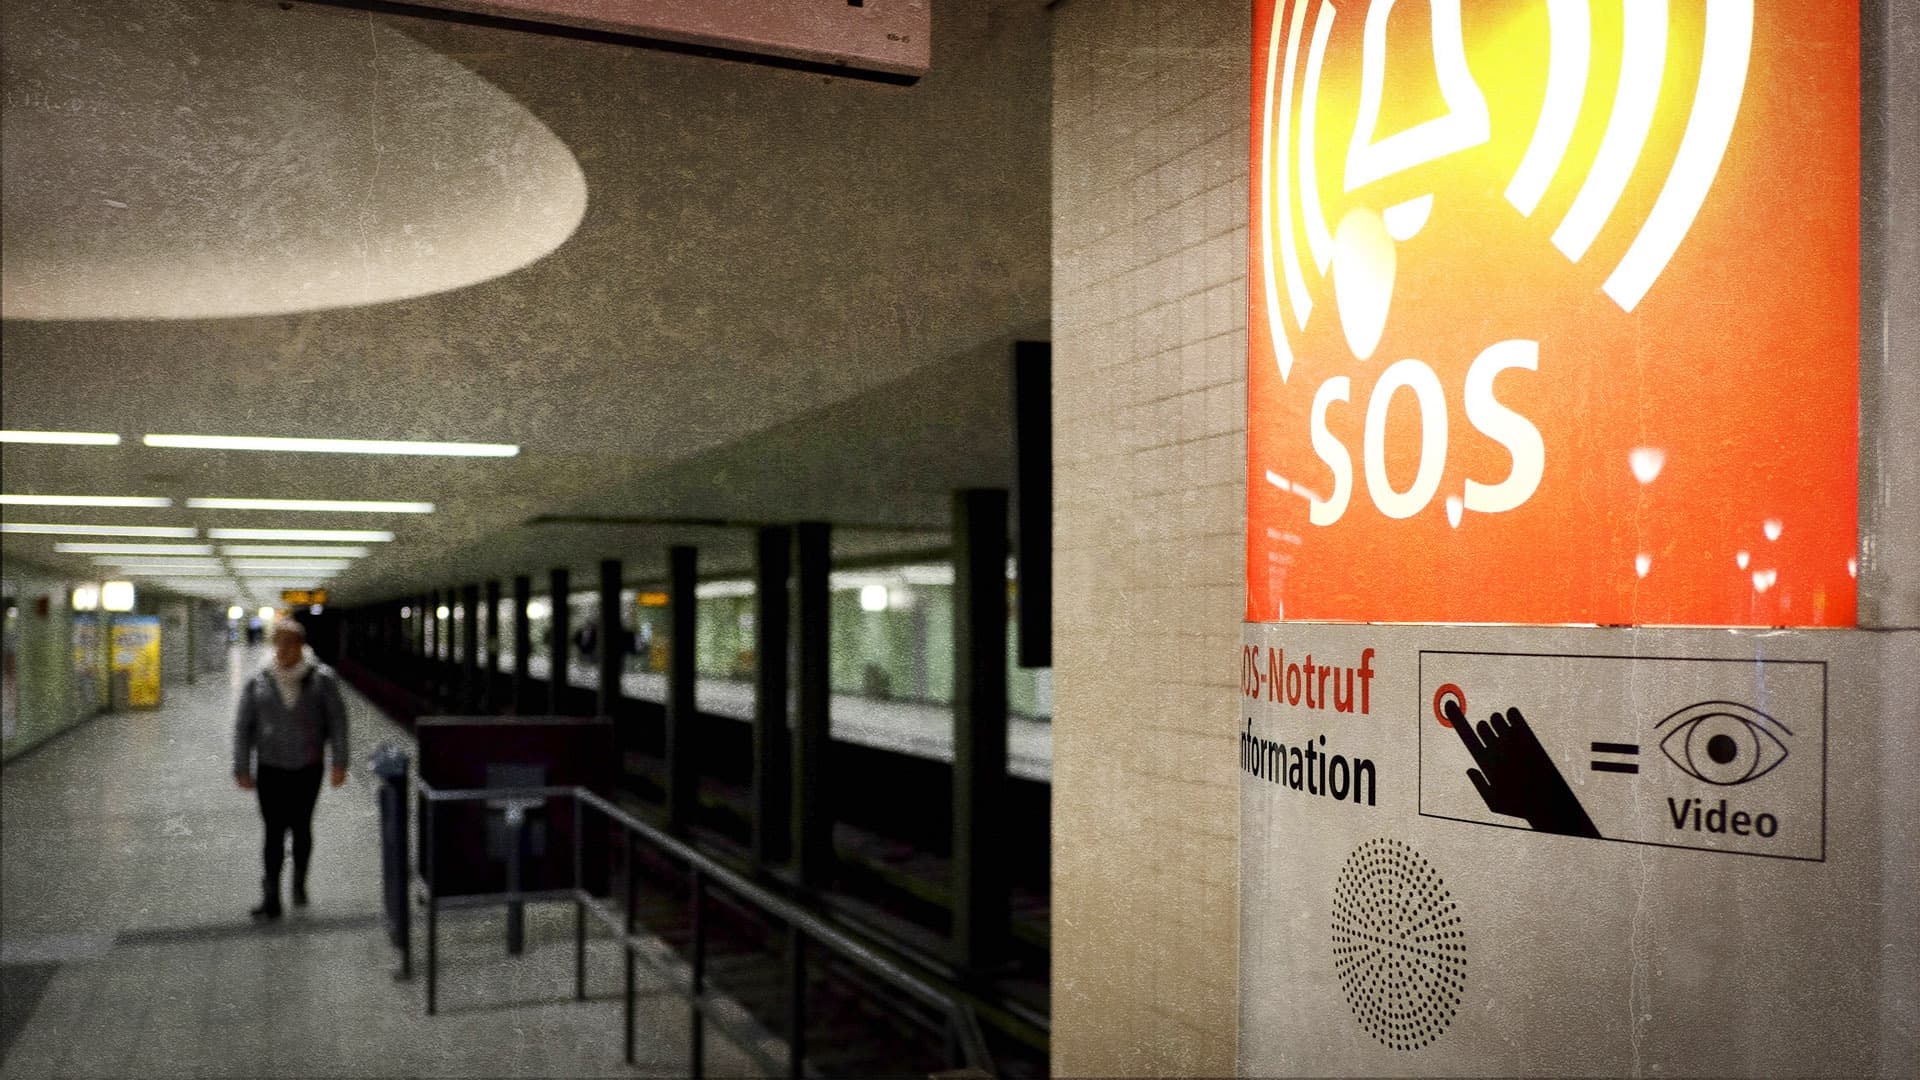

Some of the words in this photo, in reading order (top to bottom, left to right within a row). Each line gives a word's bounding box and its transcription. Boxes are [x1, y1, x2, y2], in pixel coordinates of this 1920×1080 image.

[1310, 339, 1545, 526] SOS
[1241, 645, 1375, 715] OS-Notruf
[1240, 717, 1376, 807] nformation
[1667, 797, 1778, 838] Video
